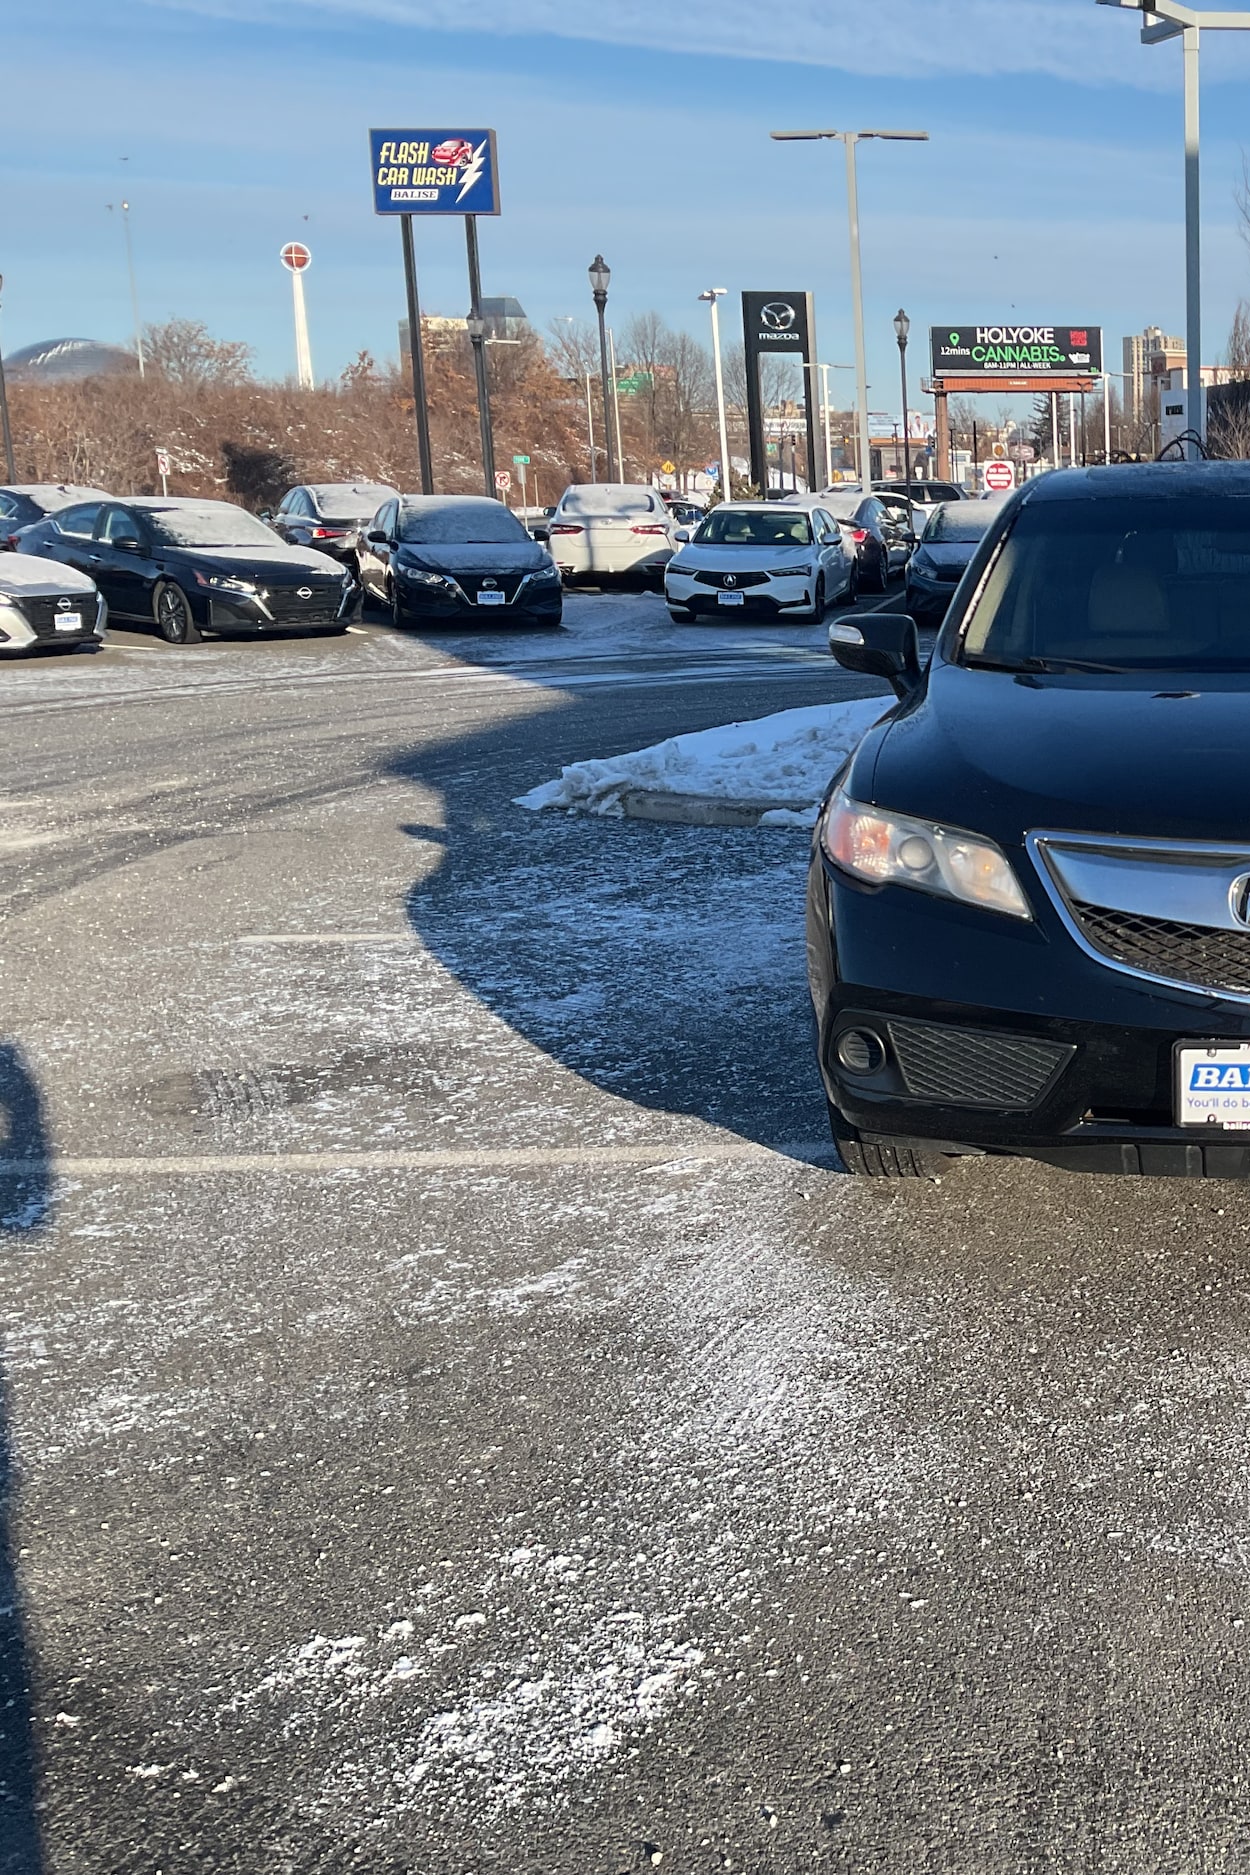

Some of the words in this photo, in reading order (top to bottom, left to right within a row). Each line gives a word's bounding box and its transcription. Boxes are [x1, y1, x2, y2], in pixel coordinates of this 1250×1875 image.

[380, 142, 429, 164] FLASH
[377, 167, 409, 185] CAR
[412, 167, 457, 185] WASH
[393, 190, 436, 199] BALISE
[976, 327, 1055, 344] HOLYOKE
[940, 346, 970, 356] 12mins
[1187, 1097, 1219, 1108] You'll
[1223, 1097, 1238, 1108] do
